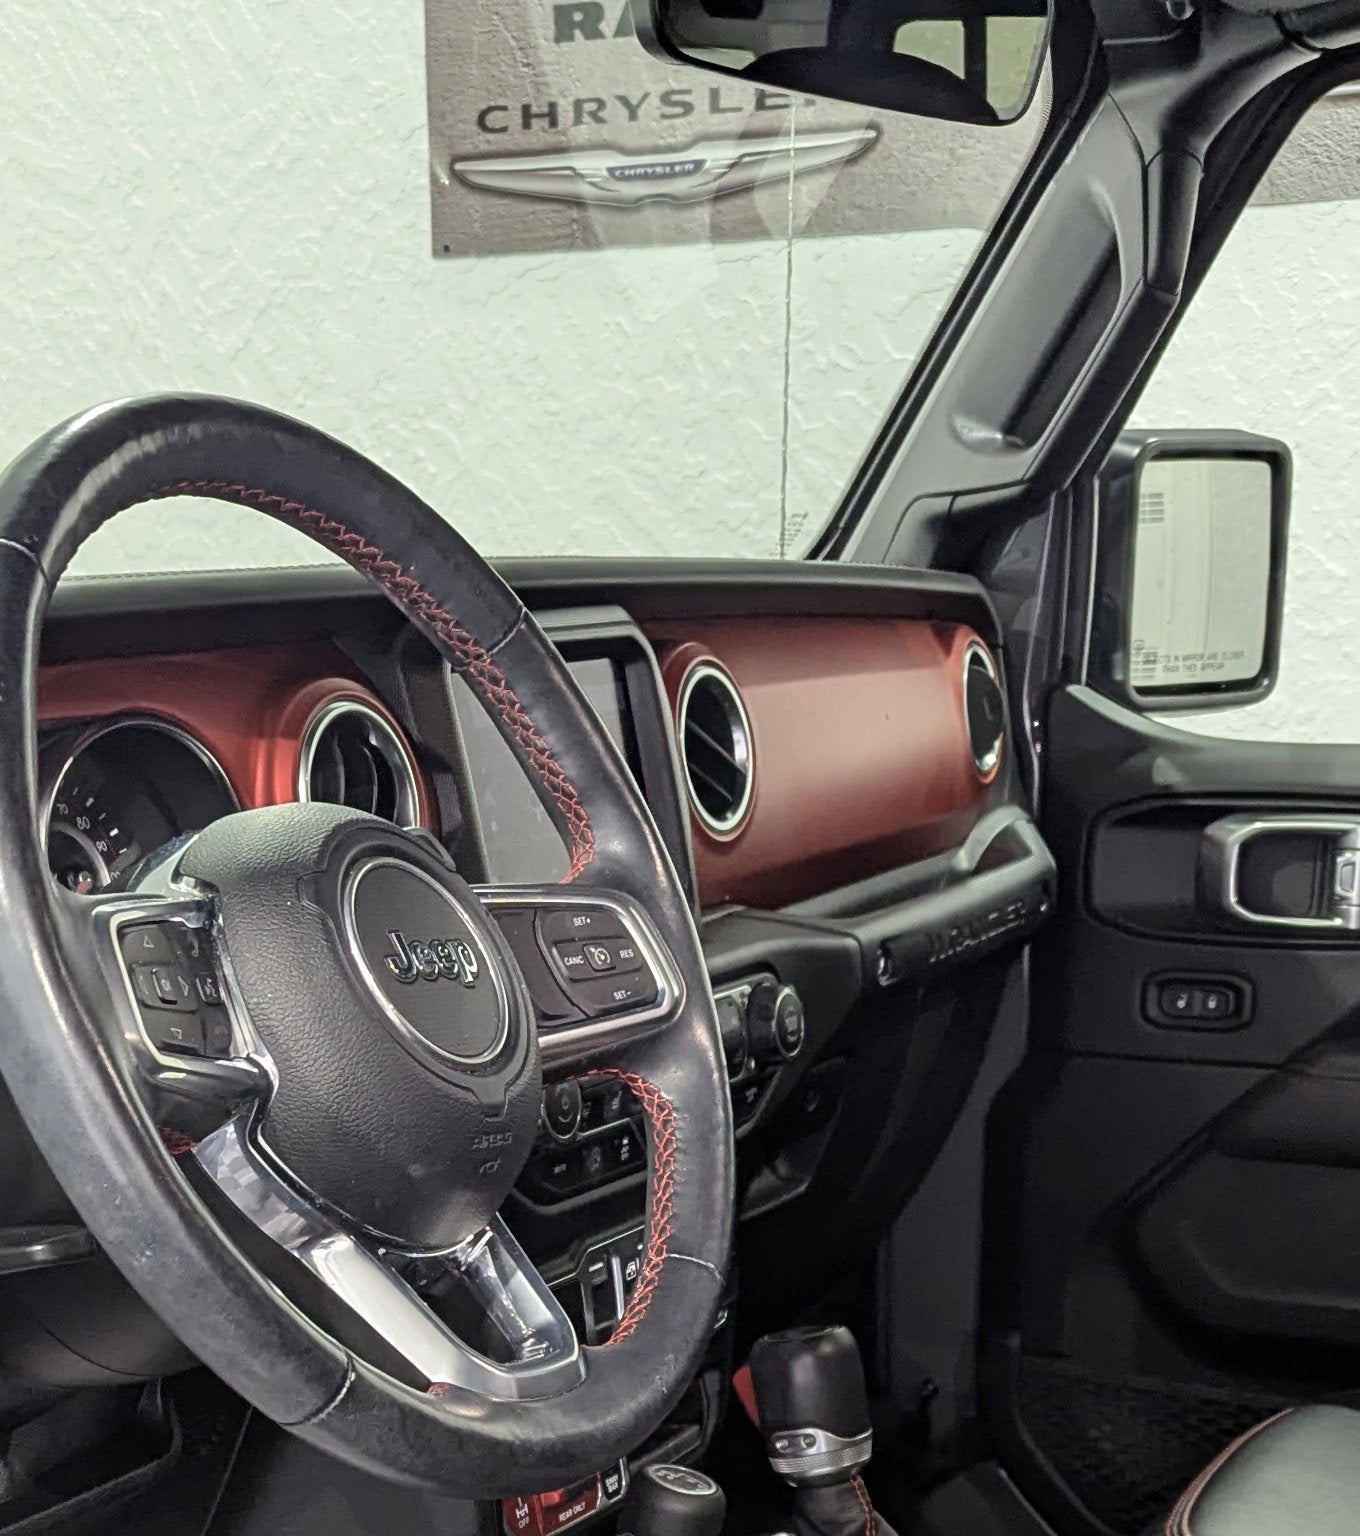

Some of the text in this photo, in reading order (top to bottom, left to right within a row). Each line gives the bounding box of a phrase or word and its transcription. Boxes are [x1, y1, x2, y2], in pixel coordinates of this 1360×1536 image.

[476, 87, 818, 134] CHRYSLE
[614, 163, 696, 179] CHRYSLER
[76, 816, 91, 830] 80
[95, 841, 108, 852] 90
[383, 929, 479, 988] Jeep
[564, 955, 585, 966] CANC
[619, 949, 635, 959] RES
